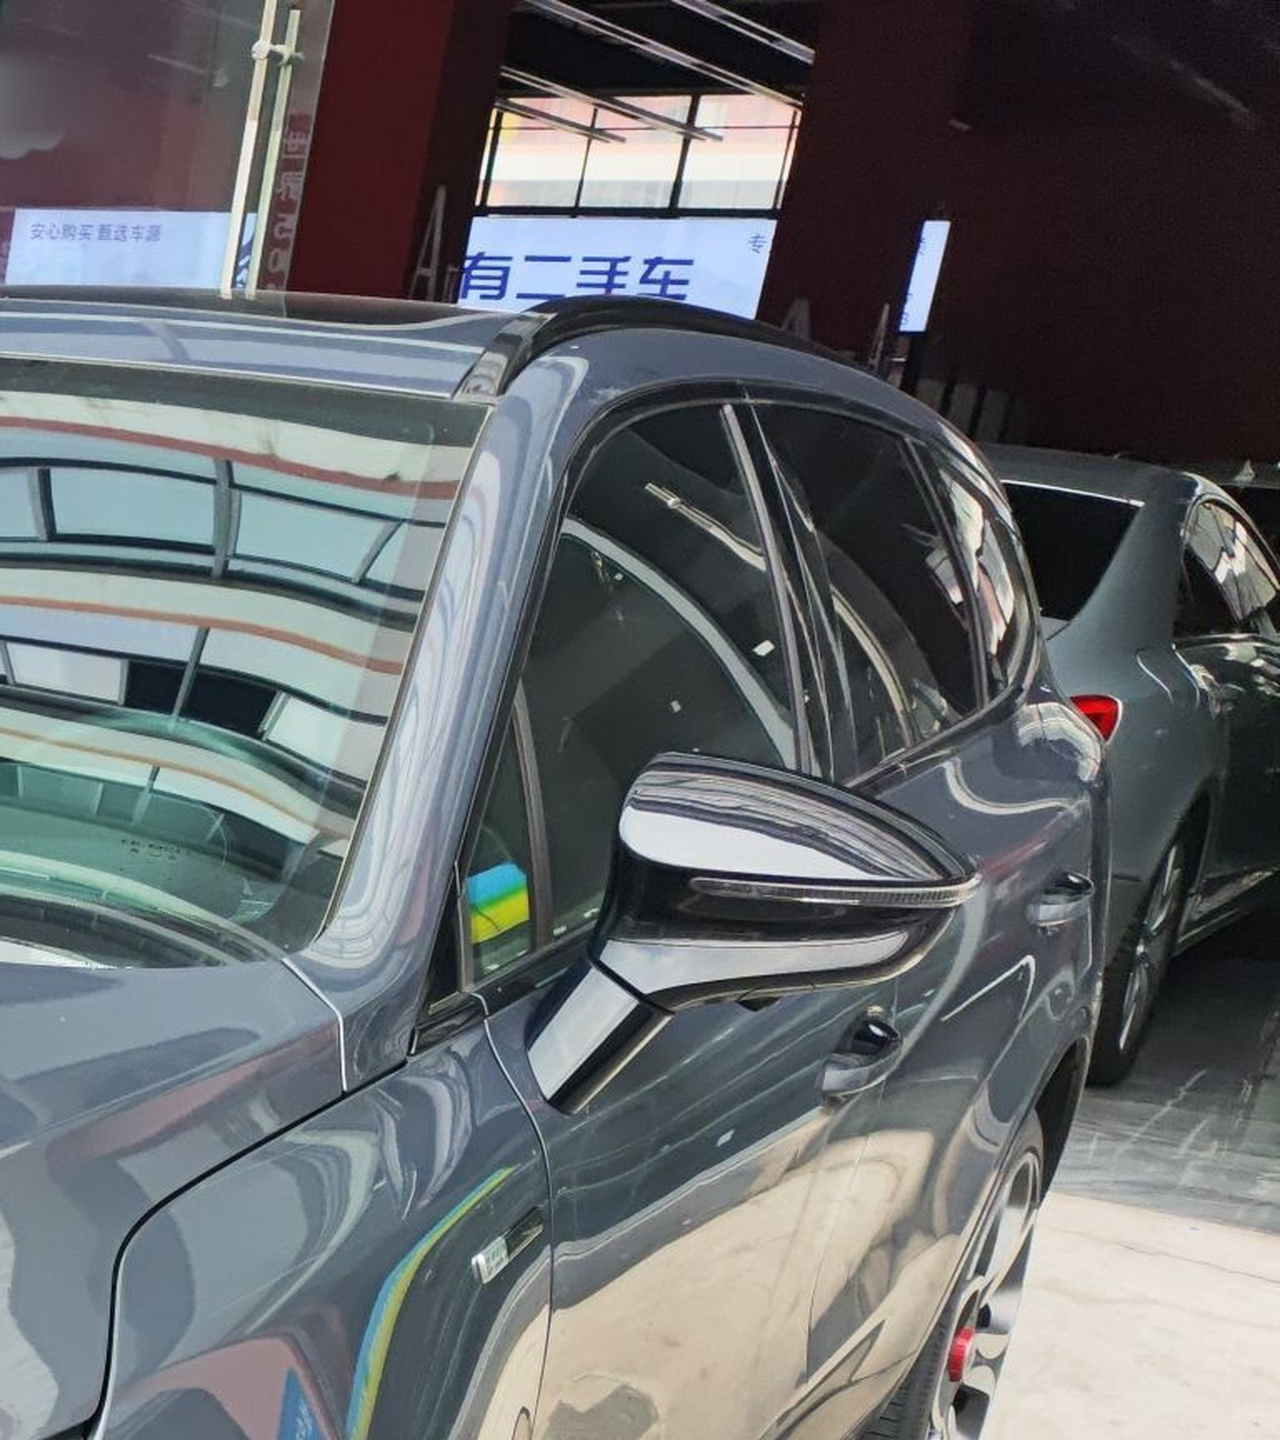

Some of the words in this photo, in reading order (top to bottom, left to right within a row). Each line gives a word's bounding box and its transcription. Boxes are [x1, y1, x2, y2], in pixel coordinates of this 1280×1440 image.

[30, 223, 93, 242] 安心购买
[460, 251, 695, 301] 有二手车
